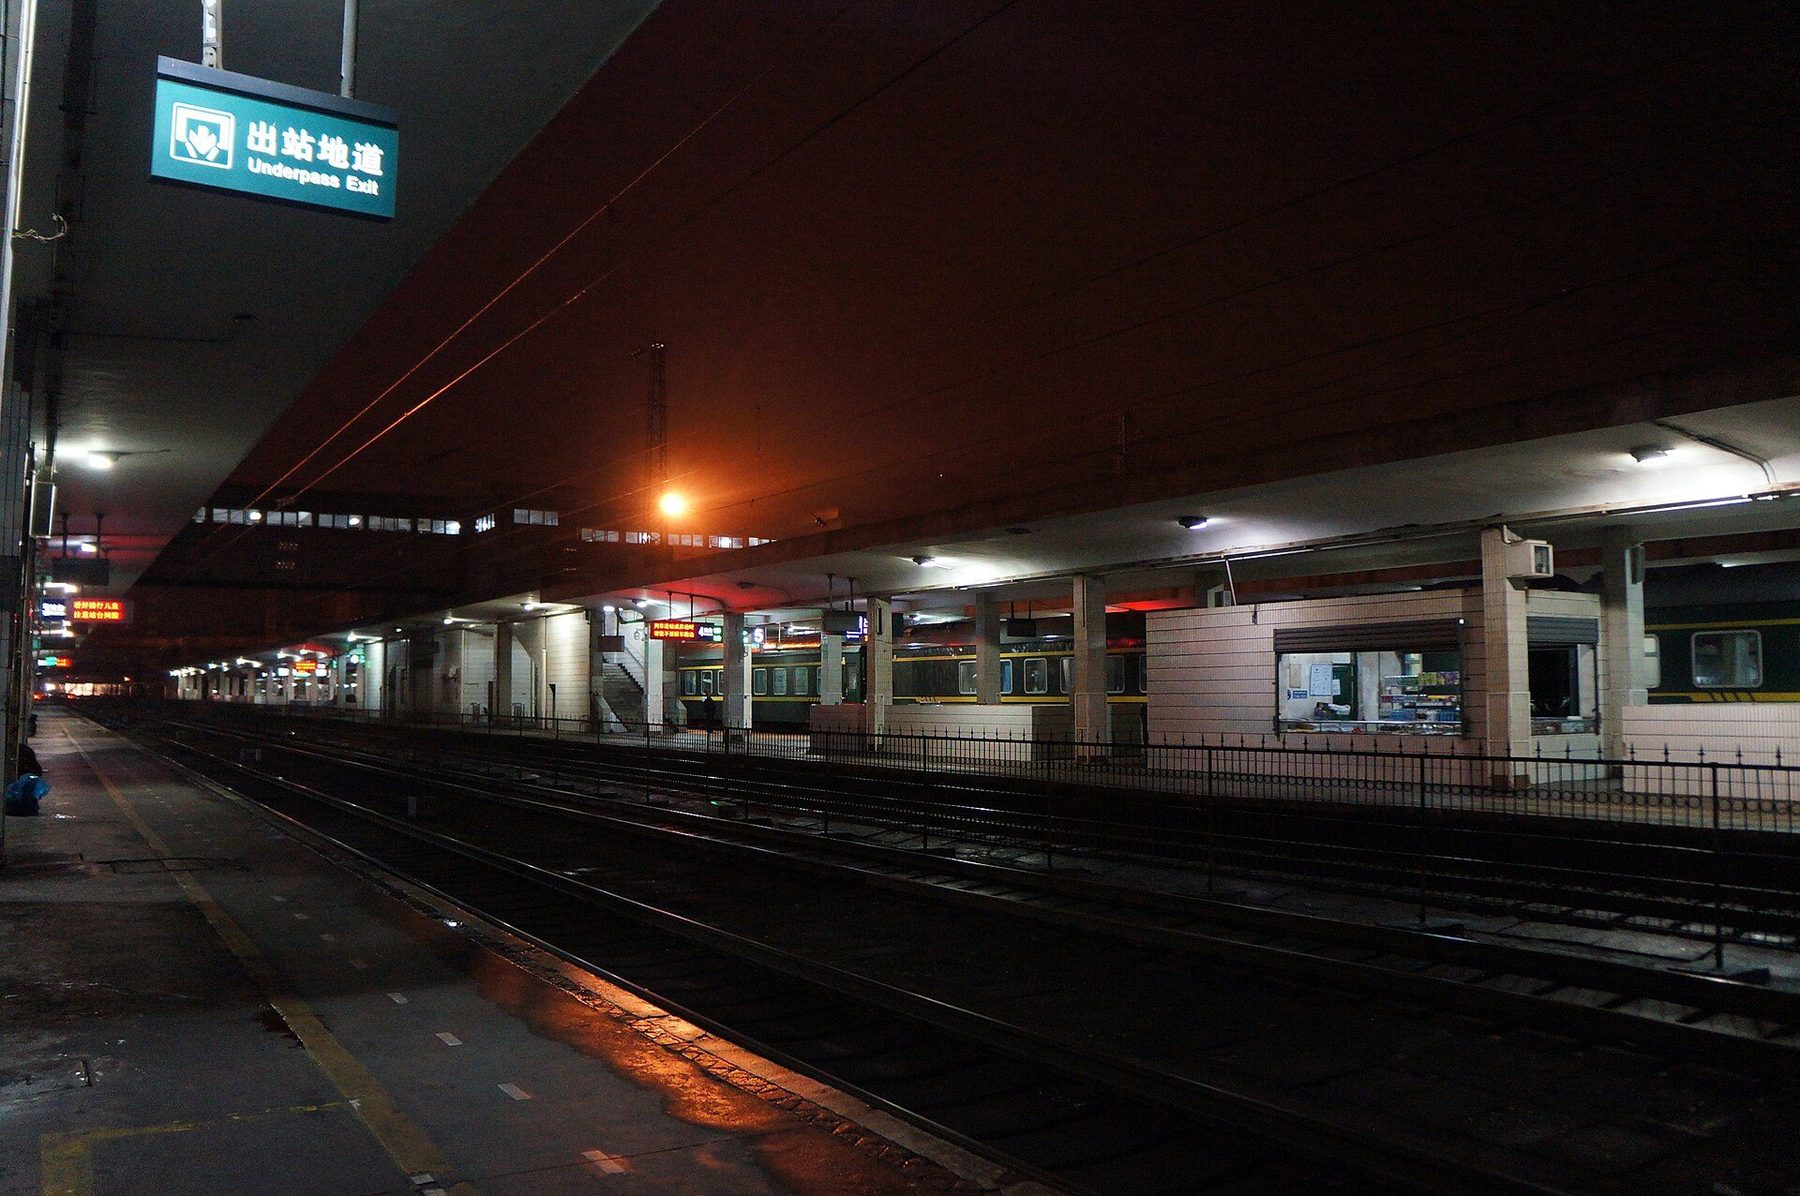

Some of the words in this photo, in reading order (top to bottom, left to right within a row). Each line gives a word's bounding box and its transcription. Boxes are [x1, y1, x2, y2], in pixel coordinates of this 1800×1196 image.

[247, 121, 384, 176] 出站地道
[247, 156, 340, 188] Underpass
[346, 174, 379, 196] Exit
